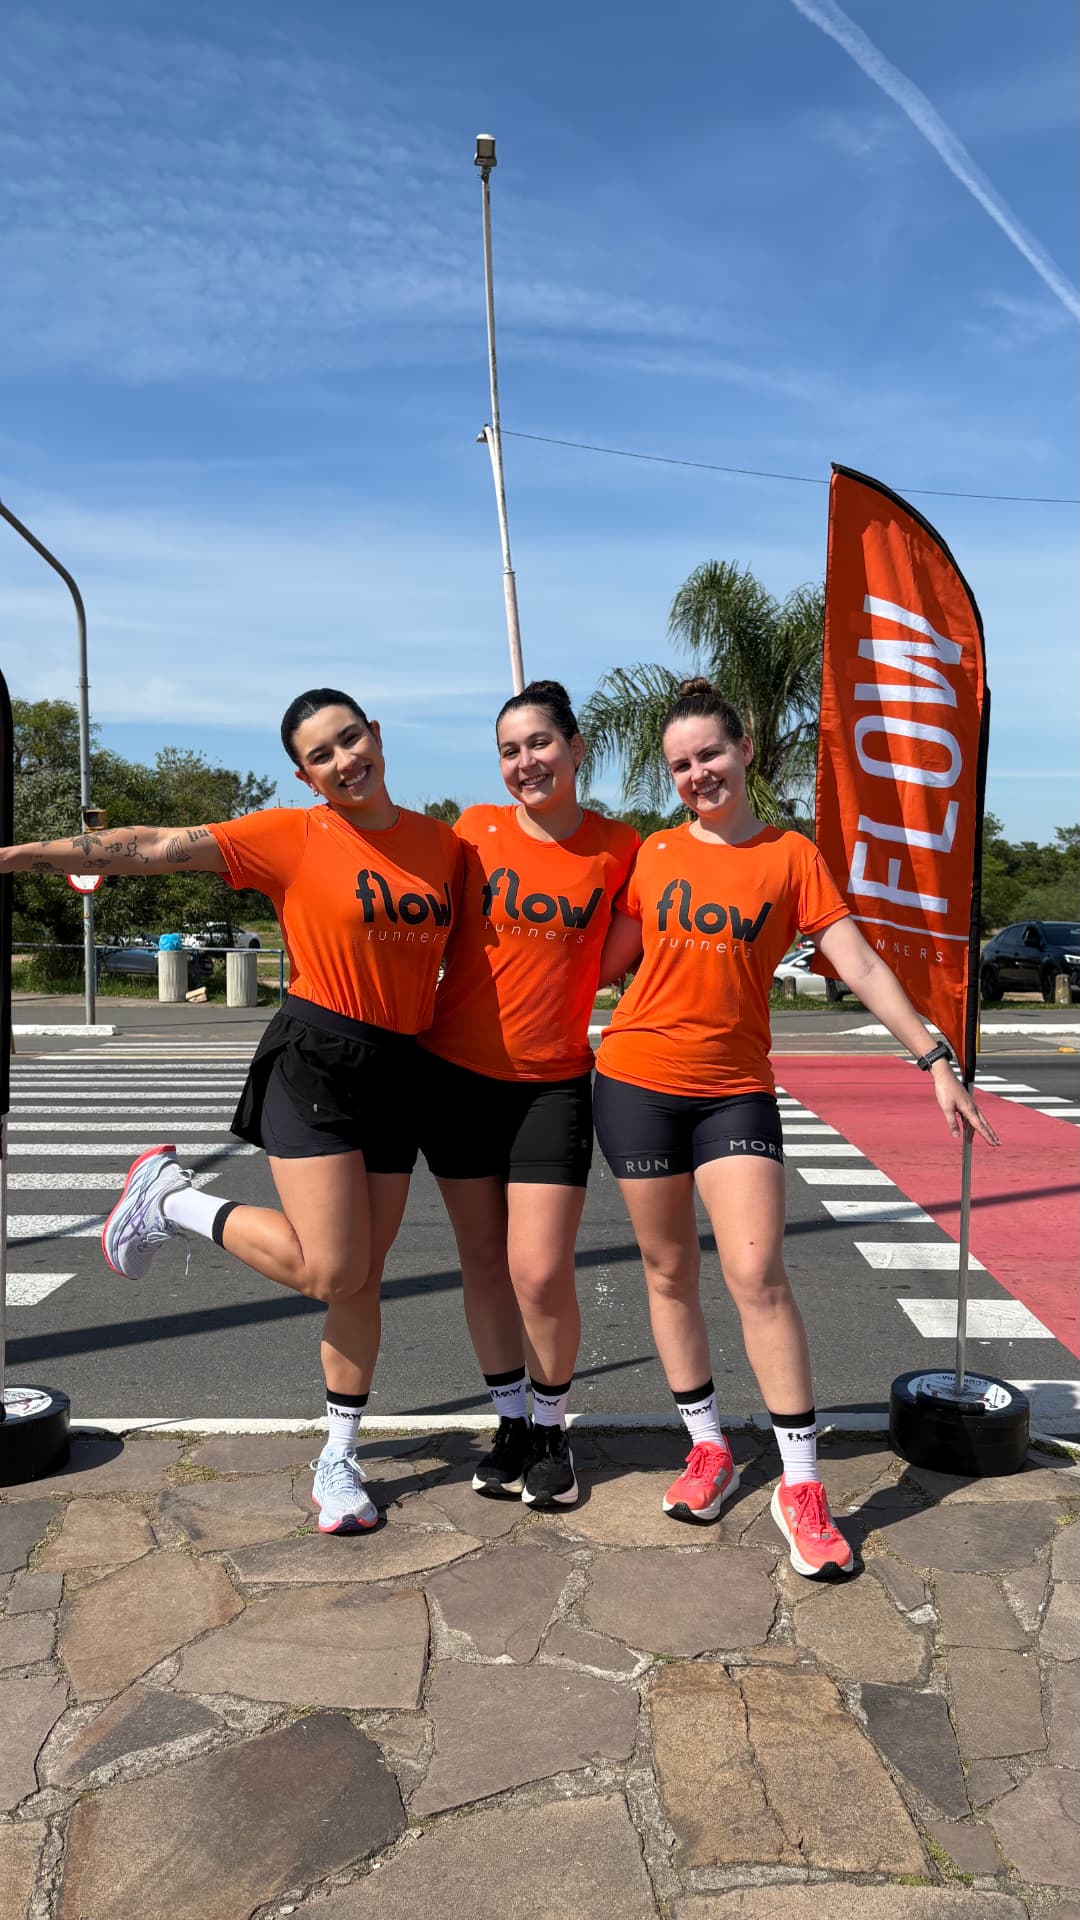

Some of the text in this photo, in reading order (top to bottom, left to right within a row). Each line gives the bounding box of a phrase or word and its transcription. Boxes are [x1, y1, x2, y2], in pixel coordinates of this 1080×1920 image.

[847, 594, 963, 914] FLOW
[356, 868, 452, 928] flow
[481, 867, 604, 929] flow
[656, 878, 774, 943] flow
[484, 920, 585, 944] runners
[659, 937, 752, 959] runners
[875, 938, 945, 963] NNERS
[625, 1158, 670, 1174] RUN
